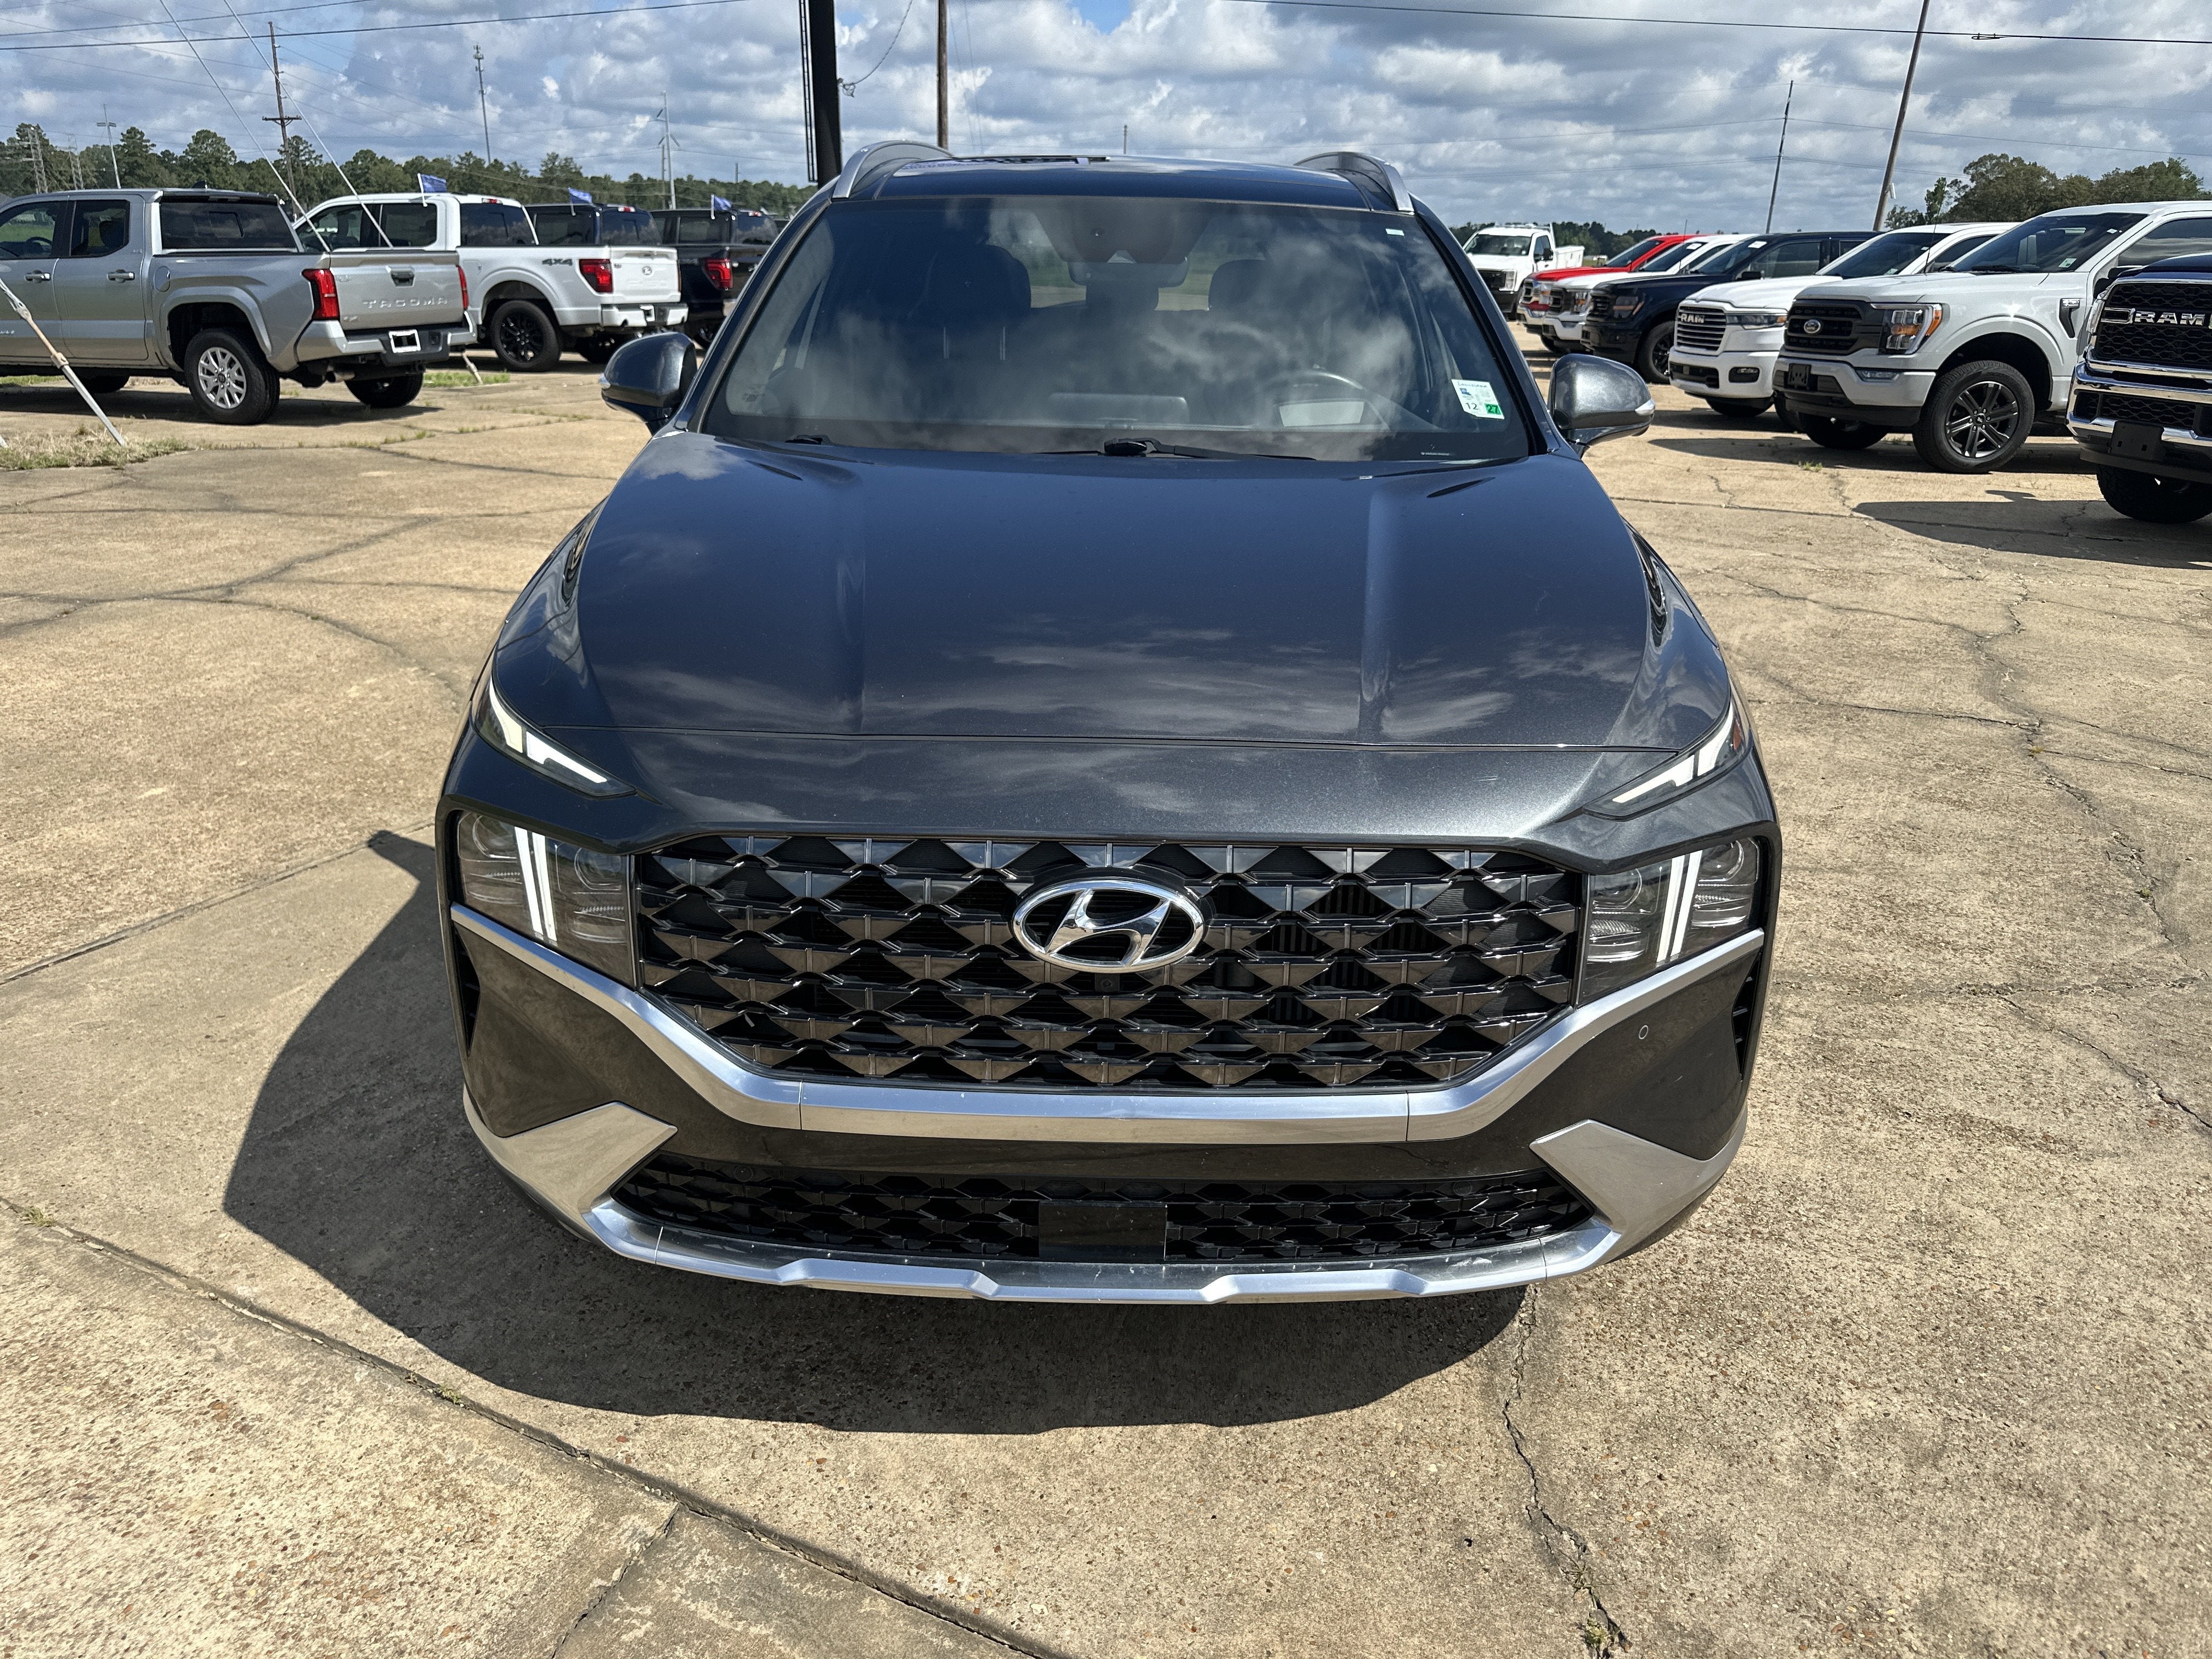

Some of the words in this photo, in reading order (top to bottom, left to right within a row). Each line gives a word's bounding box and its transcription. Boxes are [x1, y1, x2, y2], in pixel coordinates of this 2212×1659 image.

[363, 297, 448, 309] TACOMA
[1681, 313, 1705, 323] RAM
[2134, 311, 2205, 326] RAM
[1486, 404, 1499, 414] 27
